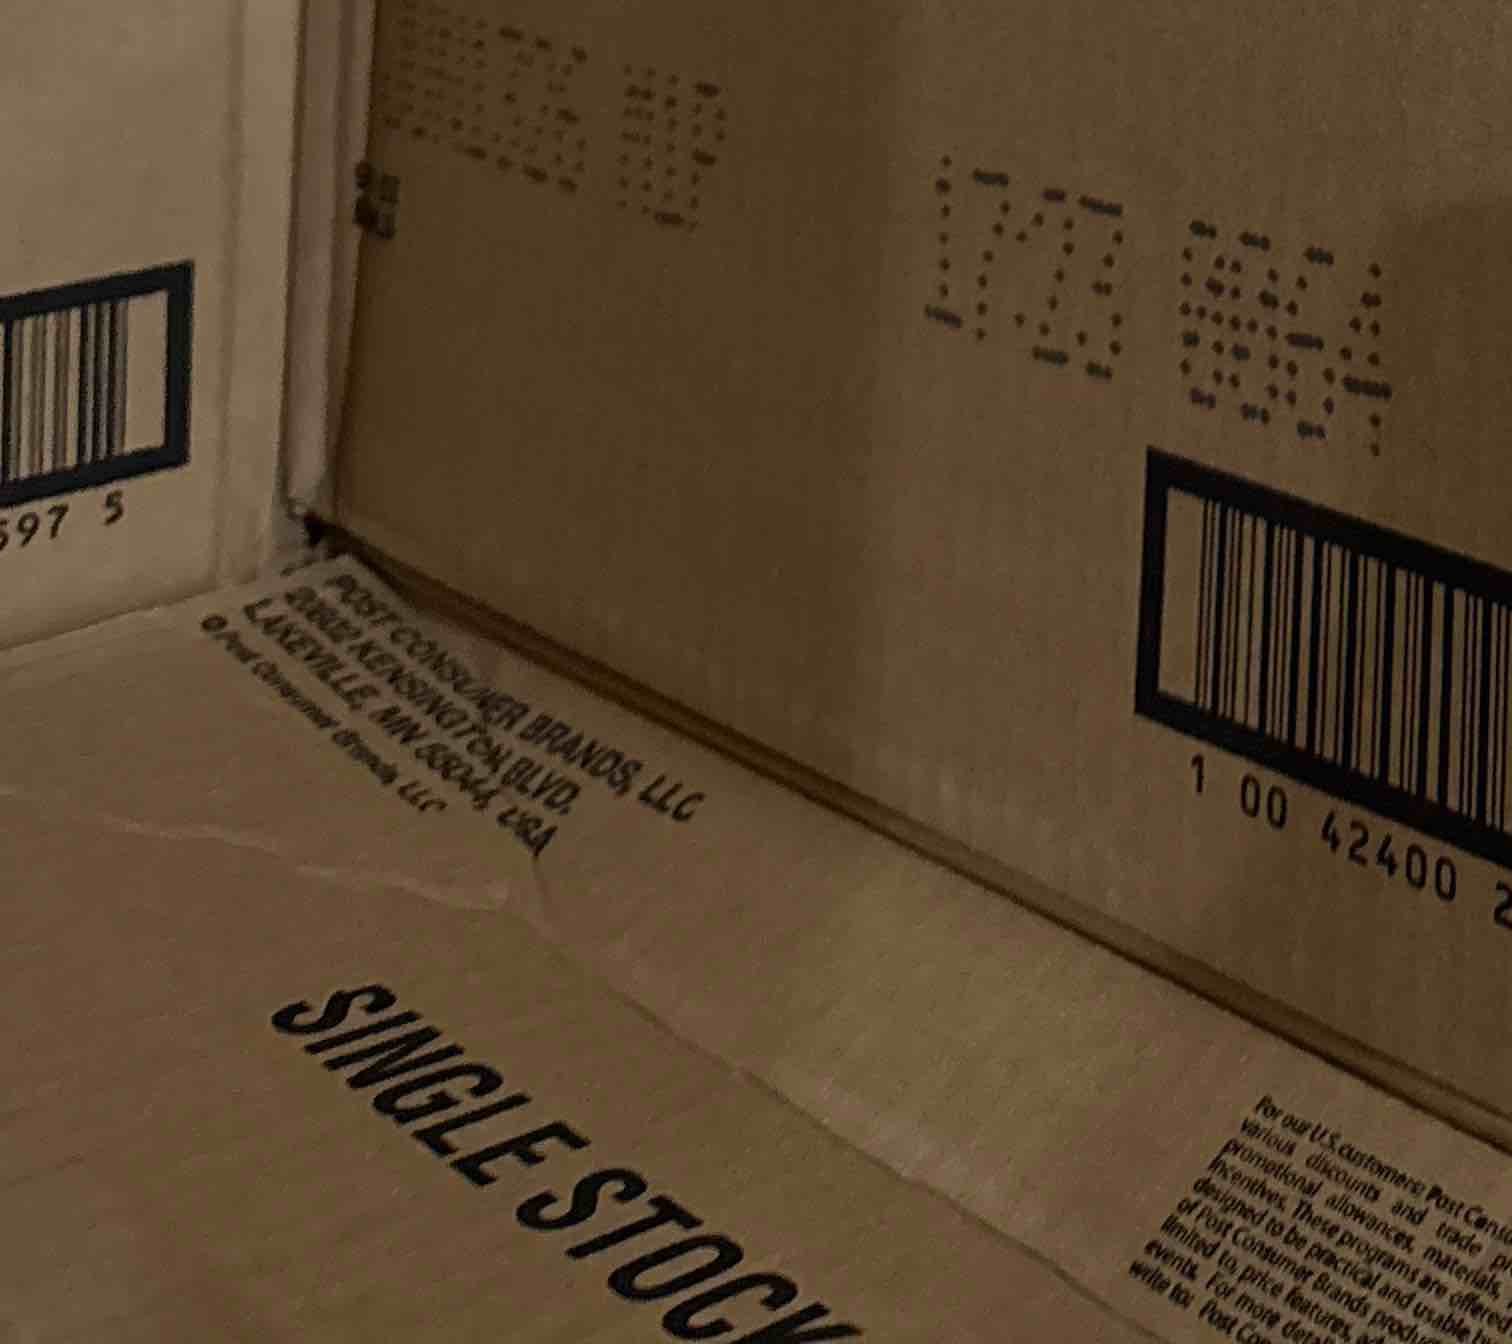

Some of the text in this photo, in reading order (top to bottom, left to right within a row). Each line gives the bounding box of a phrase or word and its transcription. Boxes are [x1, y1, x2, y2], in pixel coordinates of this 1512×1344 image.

[103, 489, 124, 526] 5
[372, 705, 430, 745] MN
[638, 774, 706, 823] LLC
[1189, 753, 1206, 794] 1
[1239, 775, 1289, 831] 00
[1320, 809, 1458, 903] 42400
[271, 983, 592, 1187] SINGLE
[1209, 1138, 1323, 1198] promotional
[1240, 1117, 1297, 1157] various
[1304, 1150, 1383, 1202] discounts
[1391, 1200, 1429, 1225] and
[1435, 1220, 1483, 1257] trade
[1256, 1095, 1282, 1121] For
[1281, 1114, 1312, 1136] our
[1426, 1185, 1465, 1220] Post
[1128, 1261, 1172, 1294] write
[1199, 1299, 1239, 1336] Post
[1160, 1214, 1222, 1257] limited
[1238, 1266, 1285, 1298] price
[1177, 1196, 1202, 1216] of
[1196, 1206, 1233, 1238] Post
[1231, 1229, 1315, 1284] Consumer
[1311, 1272, 1372, 1317] Brands
[1193, 1177, 1267, 1226] designed
[1264, 1215, 1286, 1237] to
[1283, 1225, 1308, 1251] be
[1304, 1243, 1382, 1291] practical
[1377, 1284, 1416, 1310] and
[1412, 1303, 1471, 1343] usable
[1205, 1271, 1236, 1299] For
[1234, 1292, 1281, 1328] more
[1292, 1200, 1340, 1239] These
[1337, 1230, 1420, 1282] programs
[1418, 1275, 1448, 1299] are
[1448, 1291, 1512, 1334] offered
